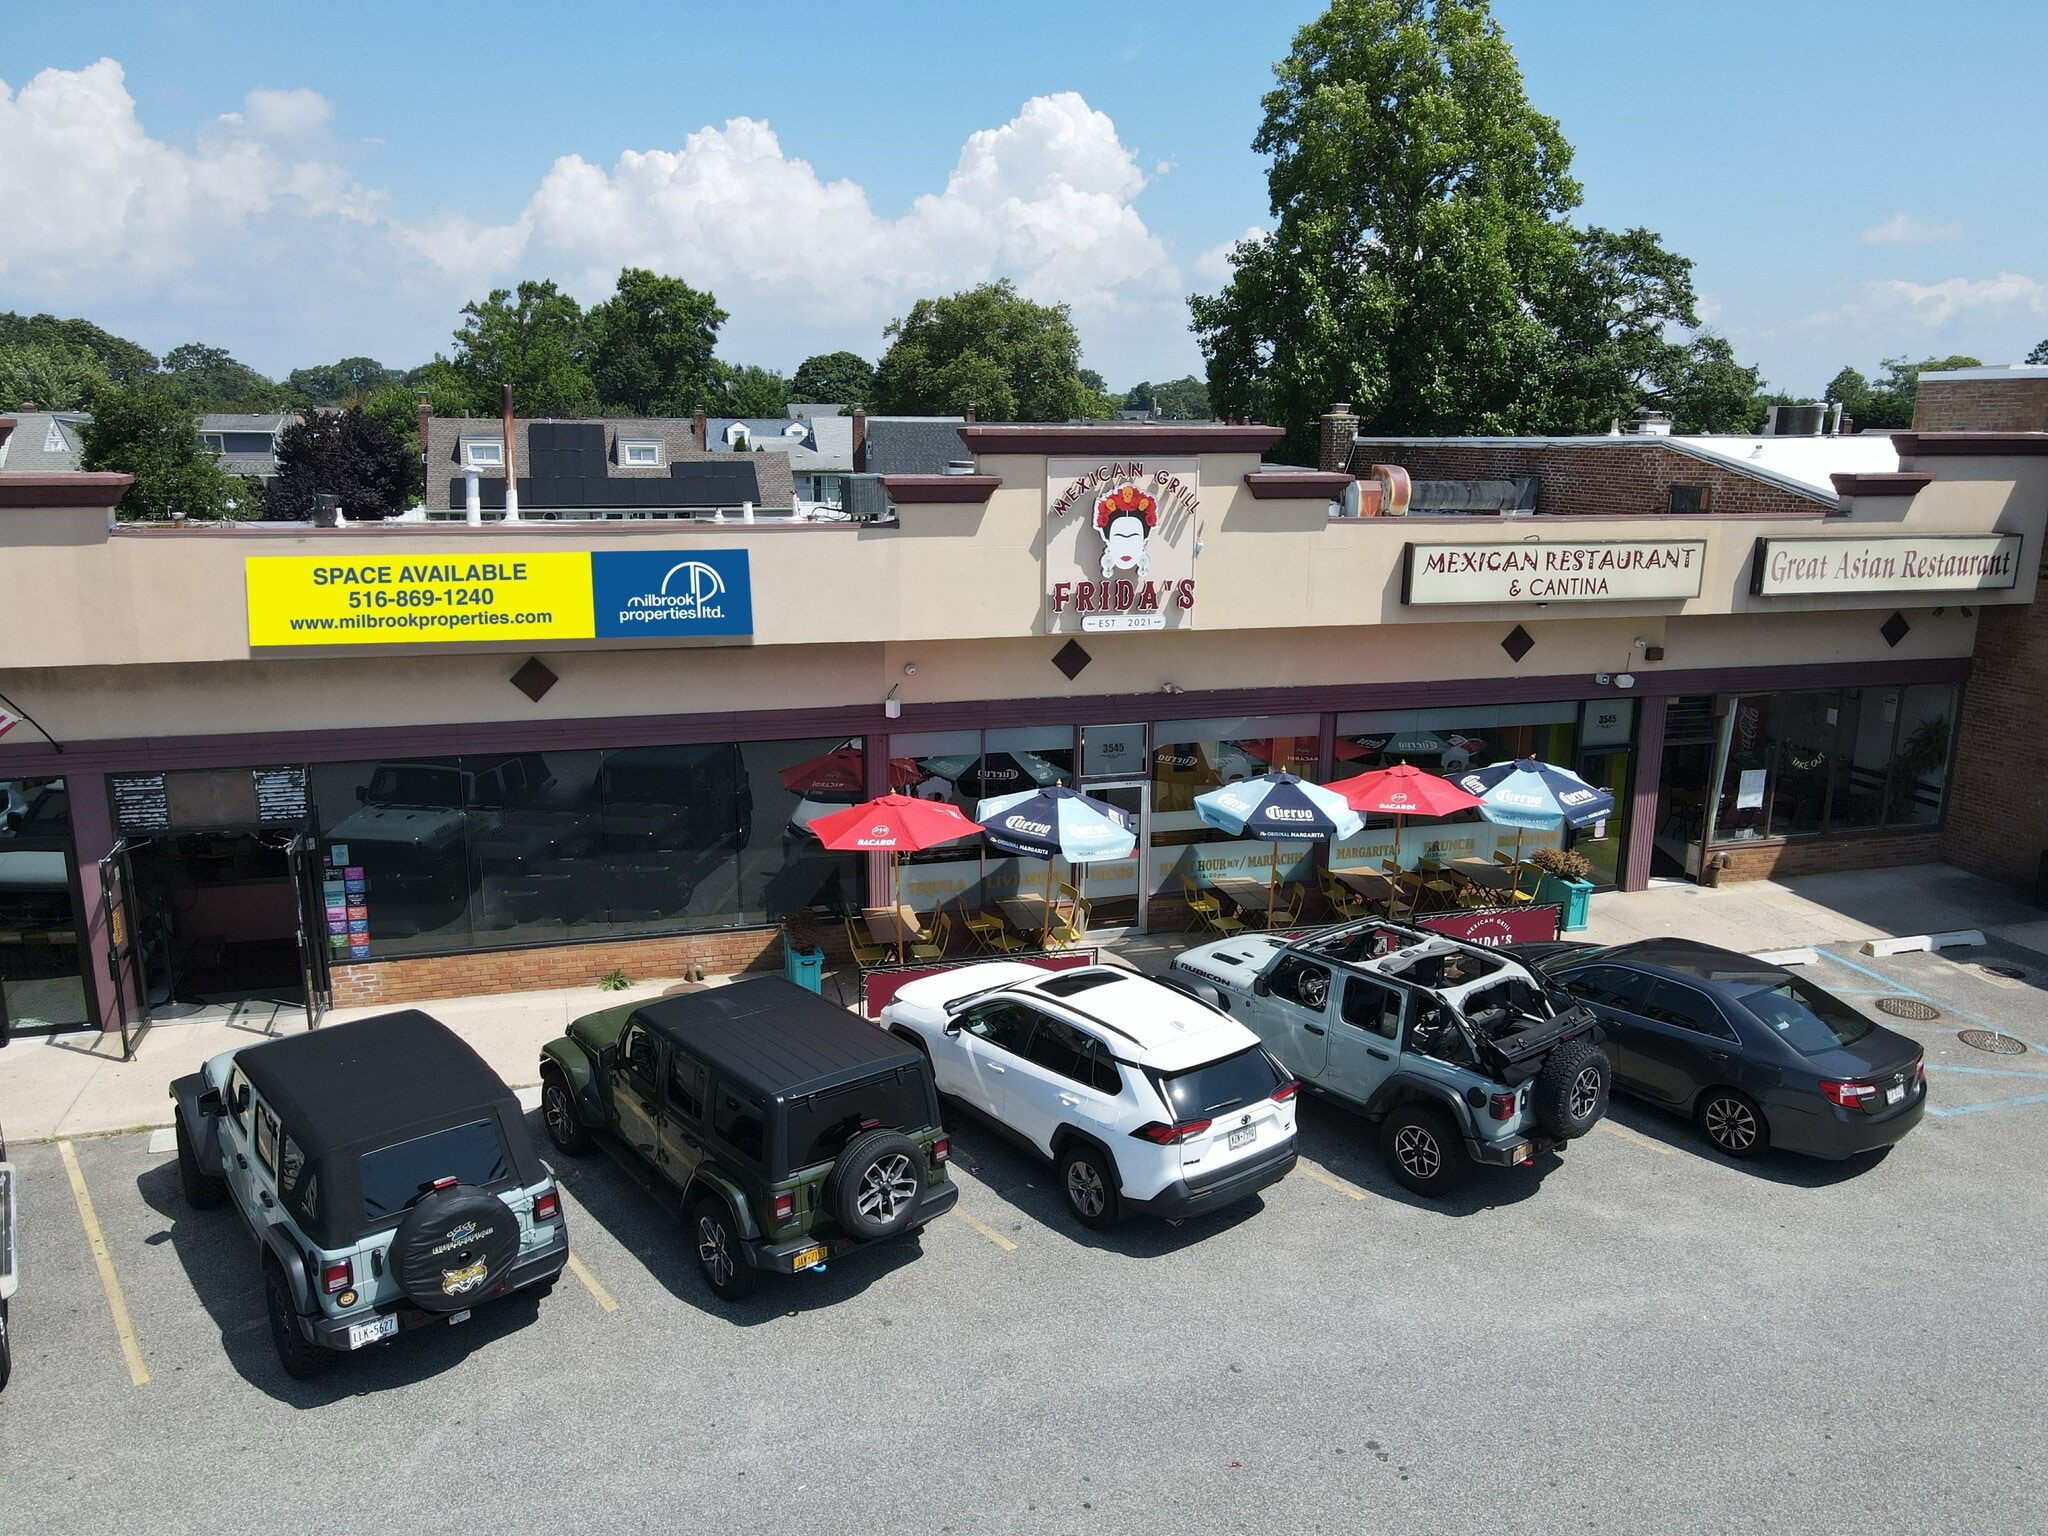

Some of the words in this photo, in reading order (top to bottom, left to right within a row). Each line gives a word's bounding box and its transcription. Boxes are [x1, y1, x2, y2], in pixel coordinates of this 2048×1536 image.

[1052, 461, 1144, 517] MEXICAN
[1154, 469, 1201, 515] GRILL
[1421, 550, 1540, 576] MEXICAN
[1545, 547, 1697, 572] RESTAURANT
[1770, 550, 1828, 585] Great
[1833, 549, 1894, 579] Asian
[1899, 548, 2012, 578] Restaurant
[313, 566, 392, 585] SPACE
[399, 563, 527, 584] AVAILABLE
[1053, 579, 1196, 613] FRIDA'S
[1509, 579, 1522, 597] &
[1529, 577, 1609, 597] CANTINA
[348, 588, 494, 609] 516-869-1240
[627, 593, 695, 607] milbrook
[290, 608, 552, 631] www.milbrookproperties.com
[619, 607, 696, 624] properties
[702, 606, 725, 618] ltd.
[1098, 619, 1119, 628] EST.
[1128, 618, 1151, 628] 2021
[1598, 714, 1617, 724] 3545
[1103, 743, 1125, 753] 3545
[1495, 789, 1543, 804] Cuervo
[1265, 805, 1313, 820] Cuervo
[1005, 815, 1052, 834] Cuervo
[1019, 844, 1049, 855] MARGARITA
[1198, 859, 1226, 871] HOUR
[1466, 917, 1494, 936] MEXICAN
[1496, 918, 1511, 932] GRILL
[1180, 963, 1231, 987] RUBICON
